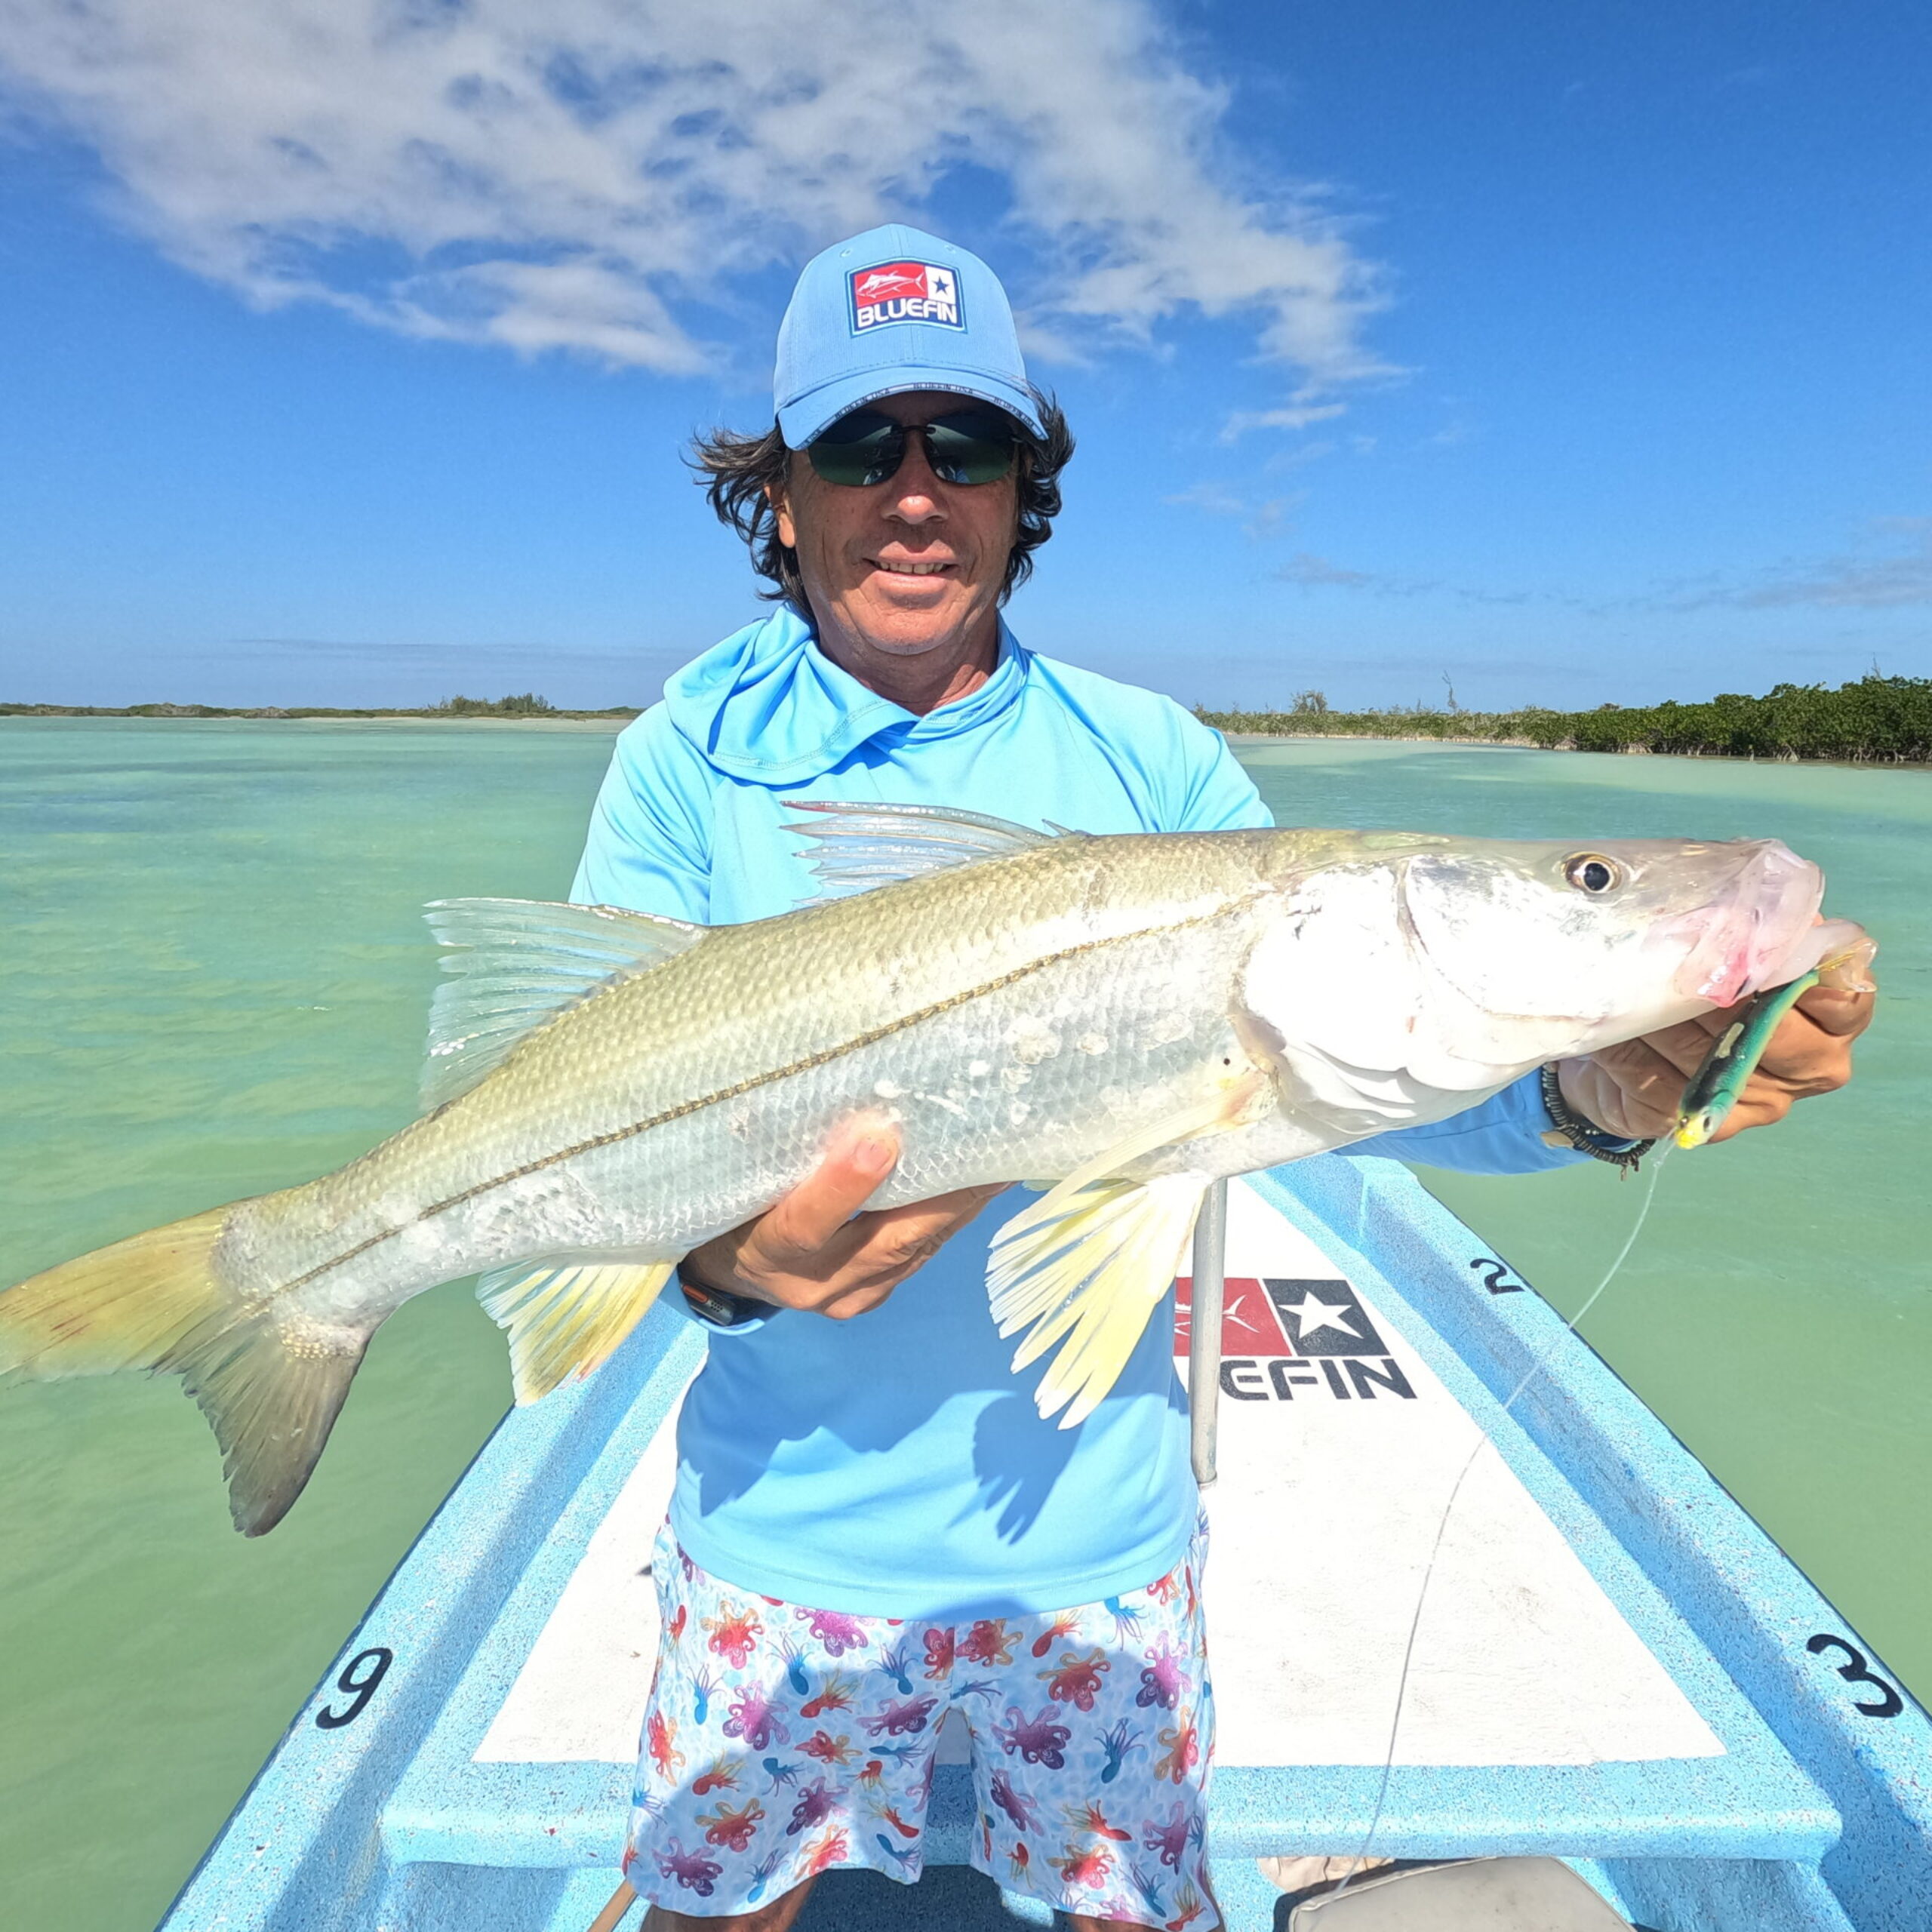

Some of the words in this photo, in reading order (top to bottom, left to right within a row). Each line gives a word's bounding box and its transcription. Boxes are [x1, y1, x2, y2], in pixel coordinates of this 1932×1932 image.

[857, 297, 958, 328] BLUEFIN
[1469, 1257, 1525, 1296] 2
[1219, 1358, 1418, 1401] EFIN
[315, 1647, 394, 1730] 9
[1805, 1633, 1904, 1718] 3
